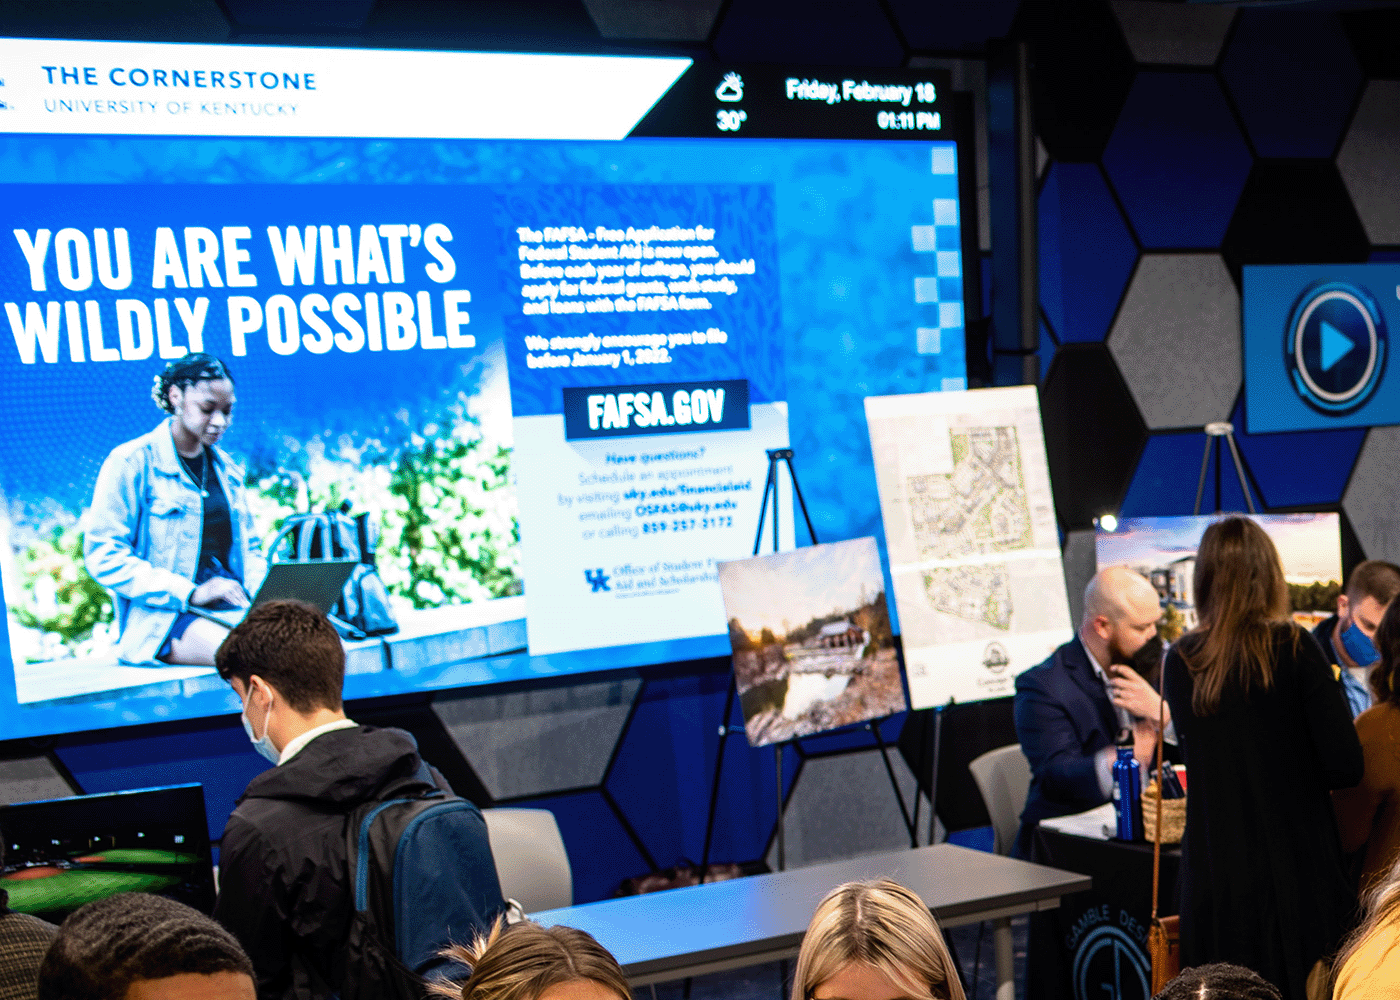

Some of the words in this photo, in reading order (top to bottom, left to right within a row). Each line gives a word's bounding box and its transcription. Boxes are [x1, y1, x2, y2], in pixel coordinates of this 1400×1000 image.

[41, 65, 98, 85] THE
[108, 67, 317, 90] CORNERSTONE
[785, 77, 841, 104] Friday,
[841, 79, 913, 107] February
[914, 81, 937, 103] 18
[43, 98, 157, 114] UNIVERSITY
[166, 101, 191, 115] OF
[200, 101, 299, 116] KENTUCKY
[716, 109, 747, 131] 30°
[876, 110, 914, 130] 01:11
[915, 111, 942, 130] PM
[517, 226, 543, 242] The
[544, 226, 588, 242] FAFSA
[596, 226, 625, 242] Free
[626, 225, 695, 245] Application
[696, 225, 715, 240] for
[13, 227, 133, 292] YOU
[151, 225, 258, 289] ARE
[267, 223, 457, 286] WHAT'S
[518, 245, 567, 260] Federal
[569, 244, 618, 260] Student
[619, 244, 642, 259] Aid
[643, 245, 654, 259] is
[655, 246, 682, 259] now
[520, 263, 563, 279] Before
[565, 262, 596, 278] each
[597, 265, 625, 280] year
[625, 261, 640, 276] of
[690, 263, 714, 280] you
[714, 258, 755, 275] should
[521, 281, 559, 299] apply
[560, 280, 579, 296] for
[579, 279, 625, 295] federal
[523, 299, 549, 315] and
[550, 299, 585, 314] loans
[585, 297, 614, 312] with
[614, 296, 636, 312] the
[637, 296, 679, 311] FAFSA
[4, 297, 210, 364] WILDLY
[227, 289, 477, 357] POSSIBLE
[525, 335, 549, 350] We
[550, 332, 601, 352] strongly
[602, 333, 667, 350] encourage
[667, 333, 692, 349] you
[692, 331, 707, 344] to
[707, 327, 728, 344] file
[526, 352, 571, 369] before
[571, 351, 621, 368] January
[587, 388, 725, 430] FAFSA.GOV
[605, 452, 637, 466] Have
[640, 446, 706, 464] questions?
[578, 467, 636, 485] Schedule
[658, 465, 733, 483] appointment
[557, 492, 574, 507] by
[576, 490, 621, 505] visiting
[578, 507, 632, 522] emailing
[598, 523, 640, 540] calling
[612, 562, 645, 577] Office
[649, 561, 660, 573] of
[663, 558, 703, 572] Student
[615, 577, 634, 590] Aid
[636, 576, 657, 589] and
[1119, 909, 1149, 946] DESI
